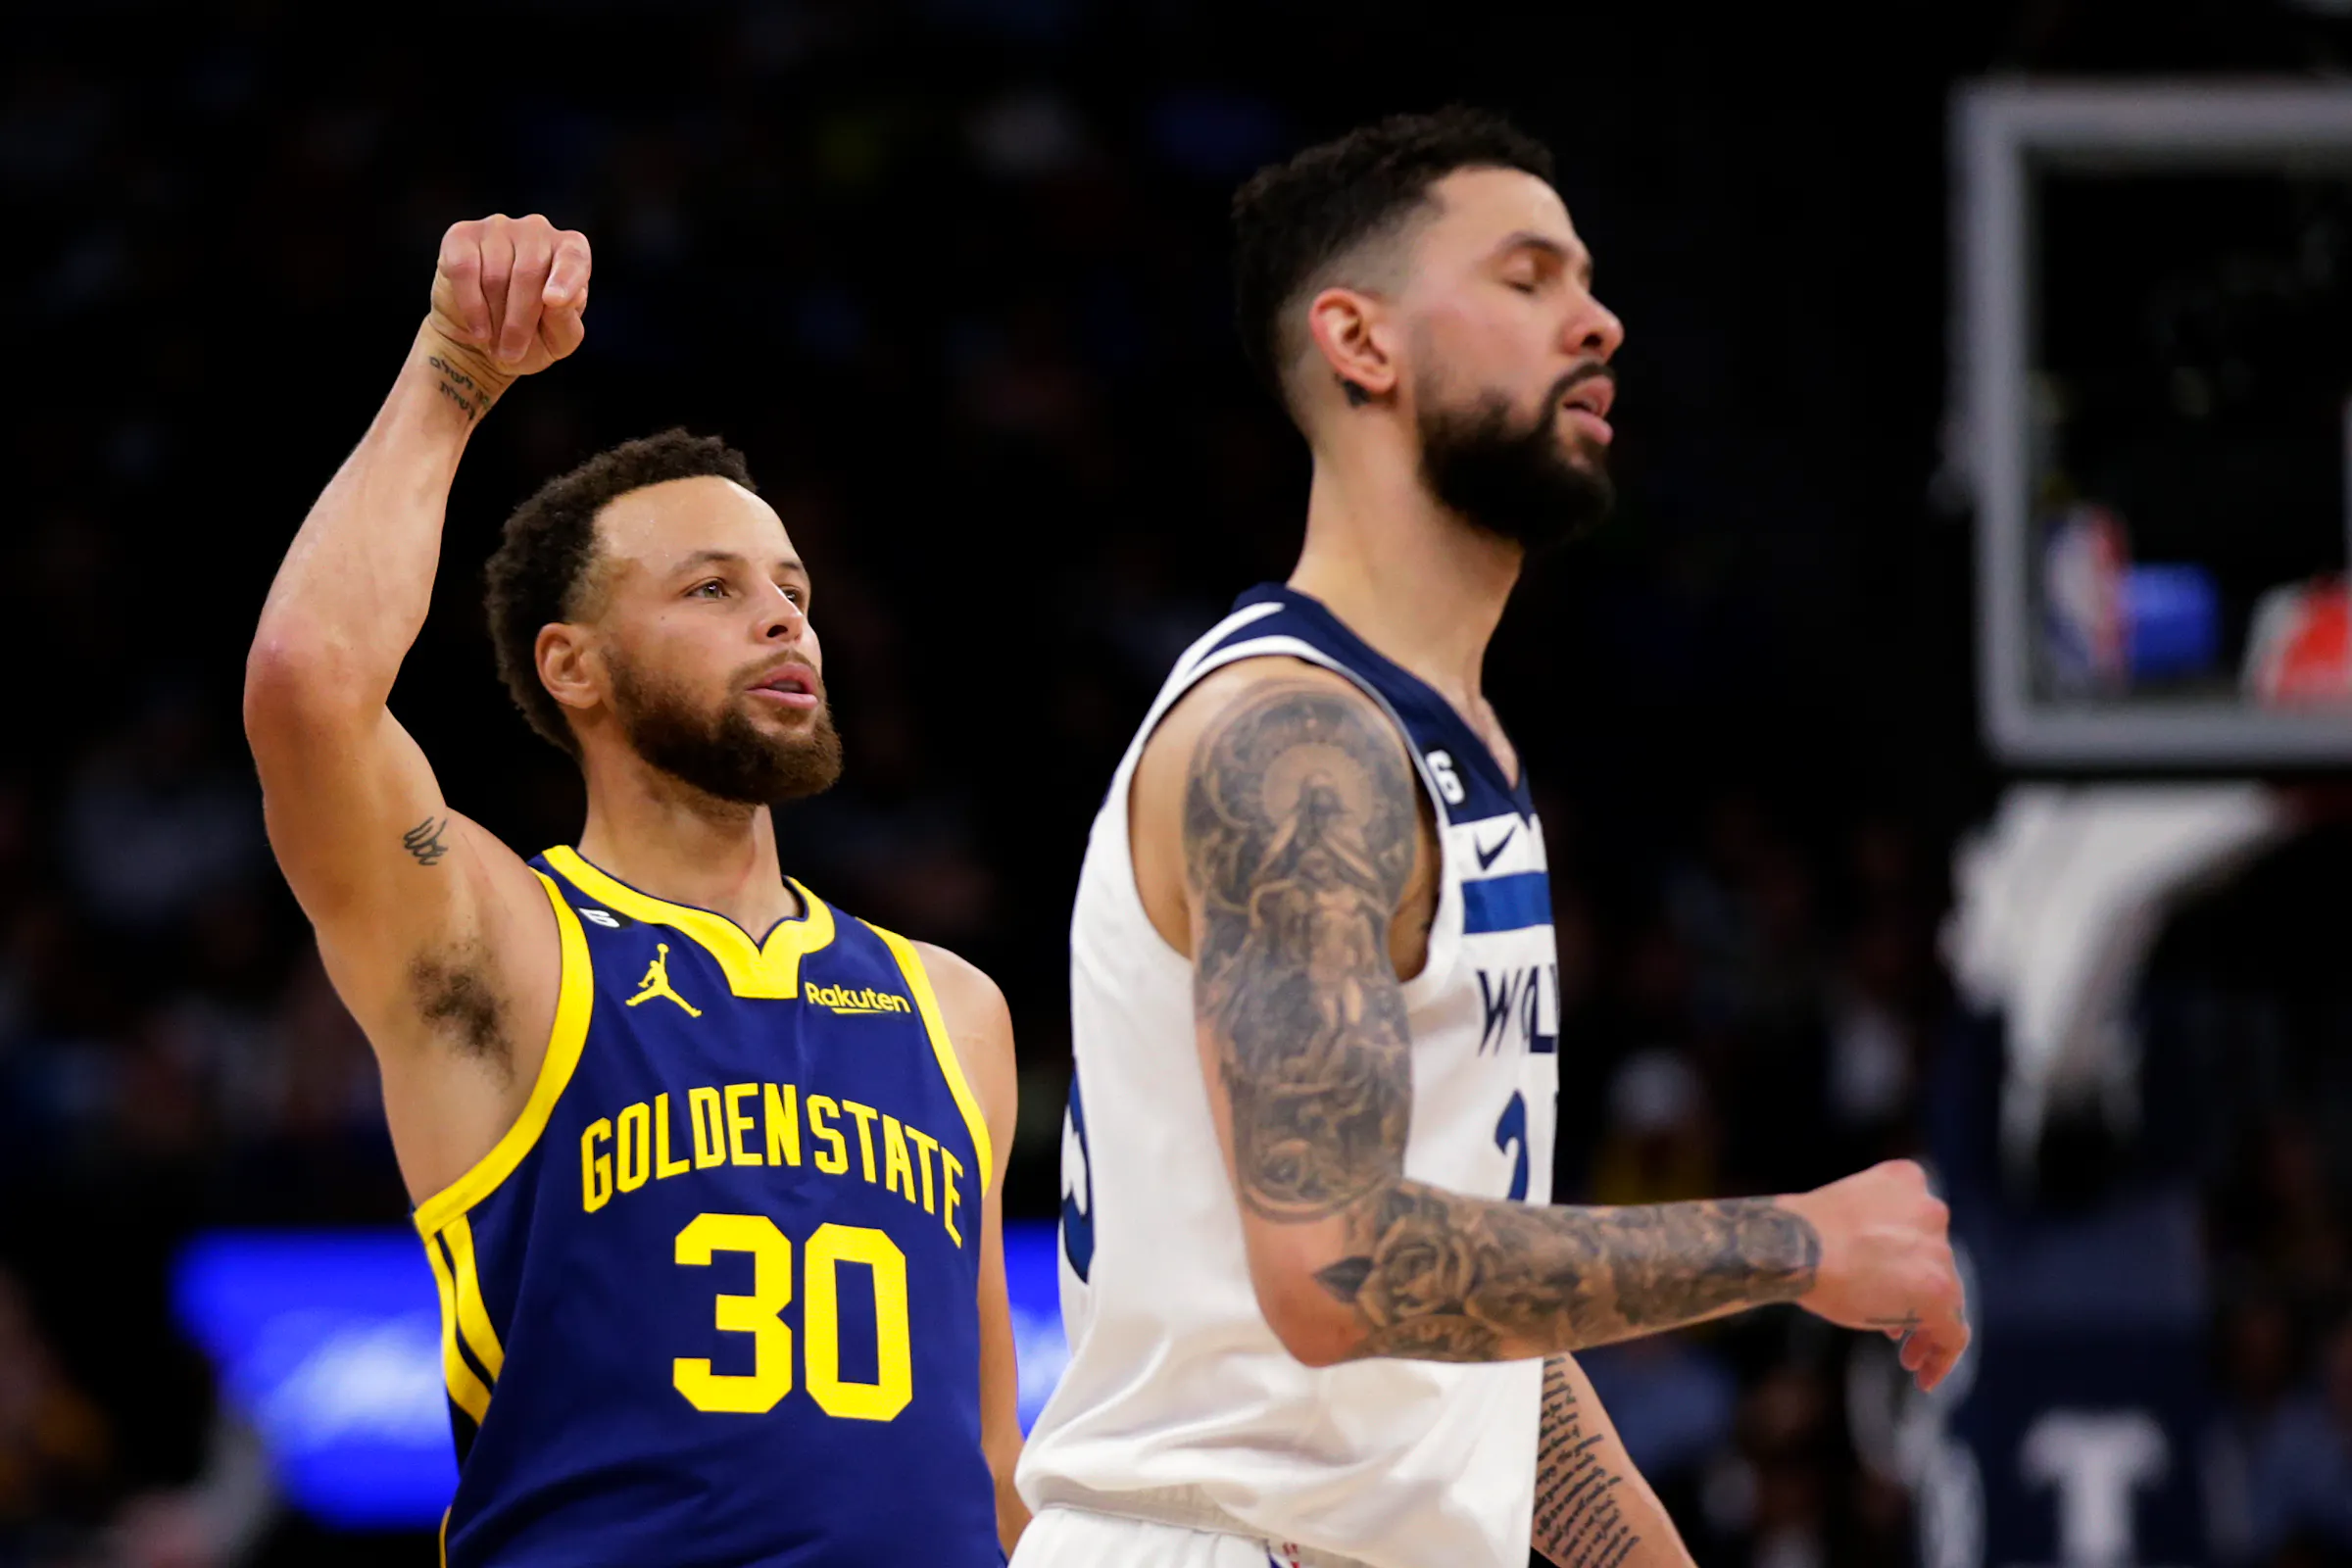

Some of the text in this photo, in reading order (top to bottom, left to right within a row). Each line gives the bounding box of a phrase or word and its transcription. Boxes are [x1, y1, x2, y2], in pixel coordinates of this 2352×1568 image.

[1425, 750, 1465, 805] 6
[804, 981, 911, 1014] Rakuten
[581, 1082, 802, 1213] GOLDEN
[806, 1094, 964, 1249] STATE
[672, 1212, 913, 1422] 30
